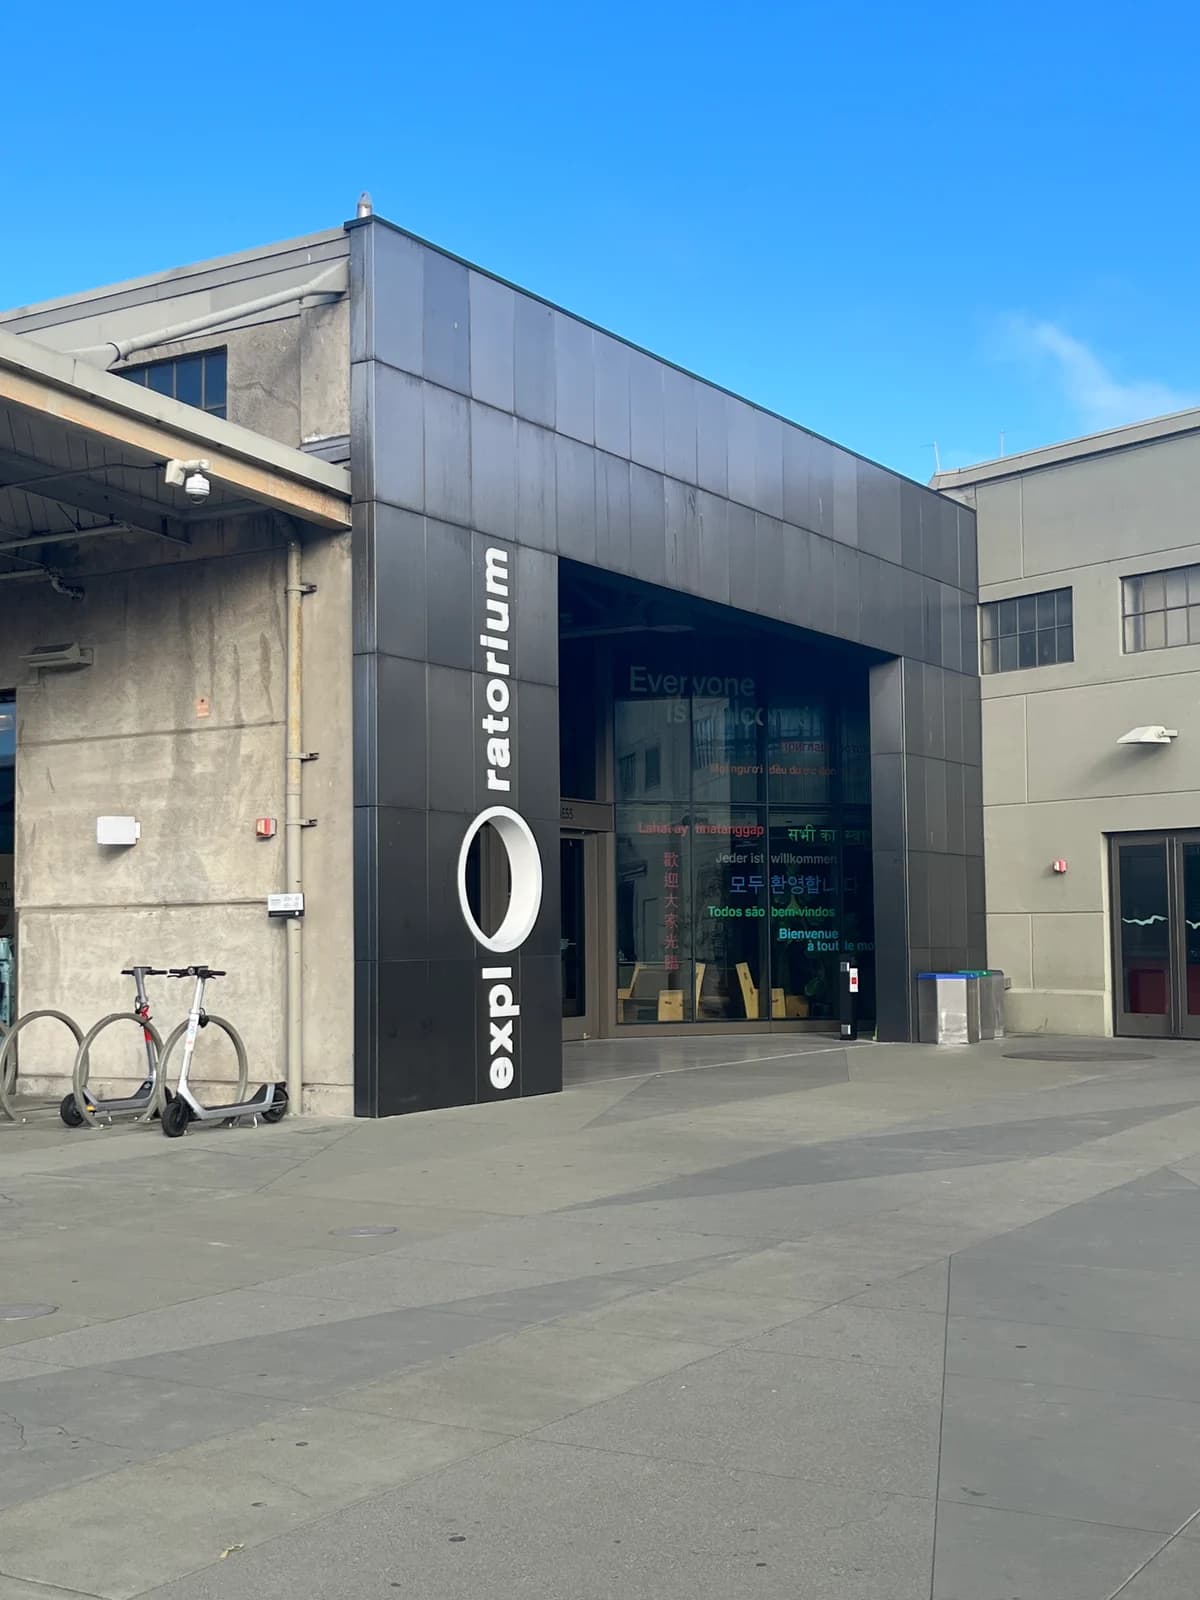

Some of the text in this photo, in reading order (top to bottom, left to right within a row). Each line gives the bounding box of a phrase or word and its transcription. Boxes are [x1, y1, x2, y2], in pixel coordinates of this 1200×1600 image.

[629, 665, 756, 700] Everyone
[715, 853, 838, 865] Jeder ist willkommen
[729, 875, 765, 896] 모두
[706, 905, 743, 918] Todos
[744, 906, 766, 918] são
[778, 927, 839, 940] Bienvenue
[816, 940, 839, 951] tout
[844, 940, 856, 951] le
